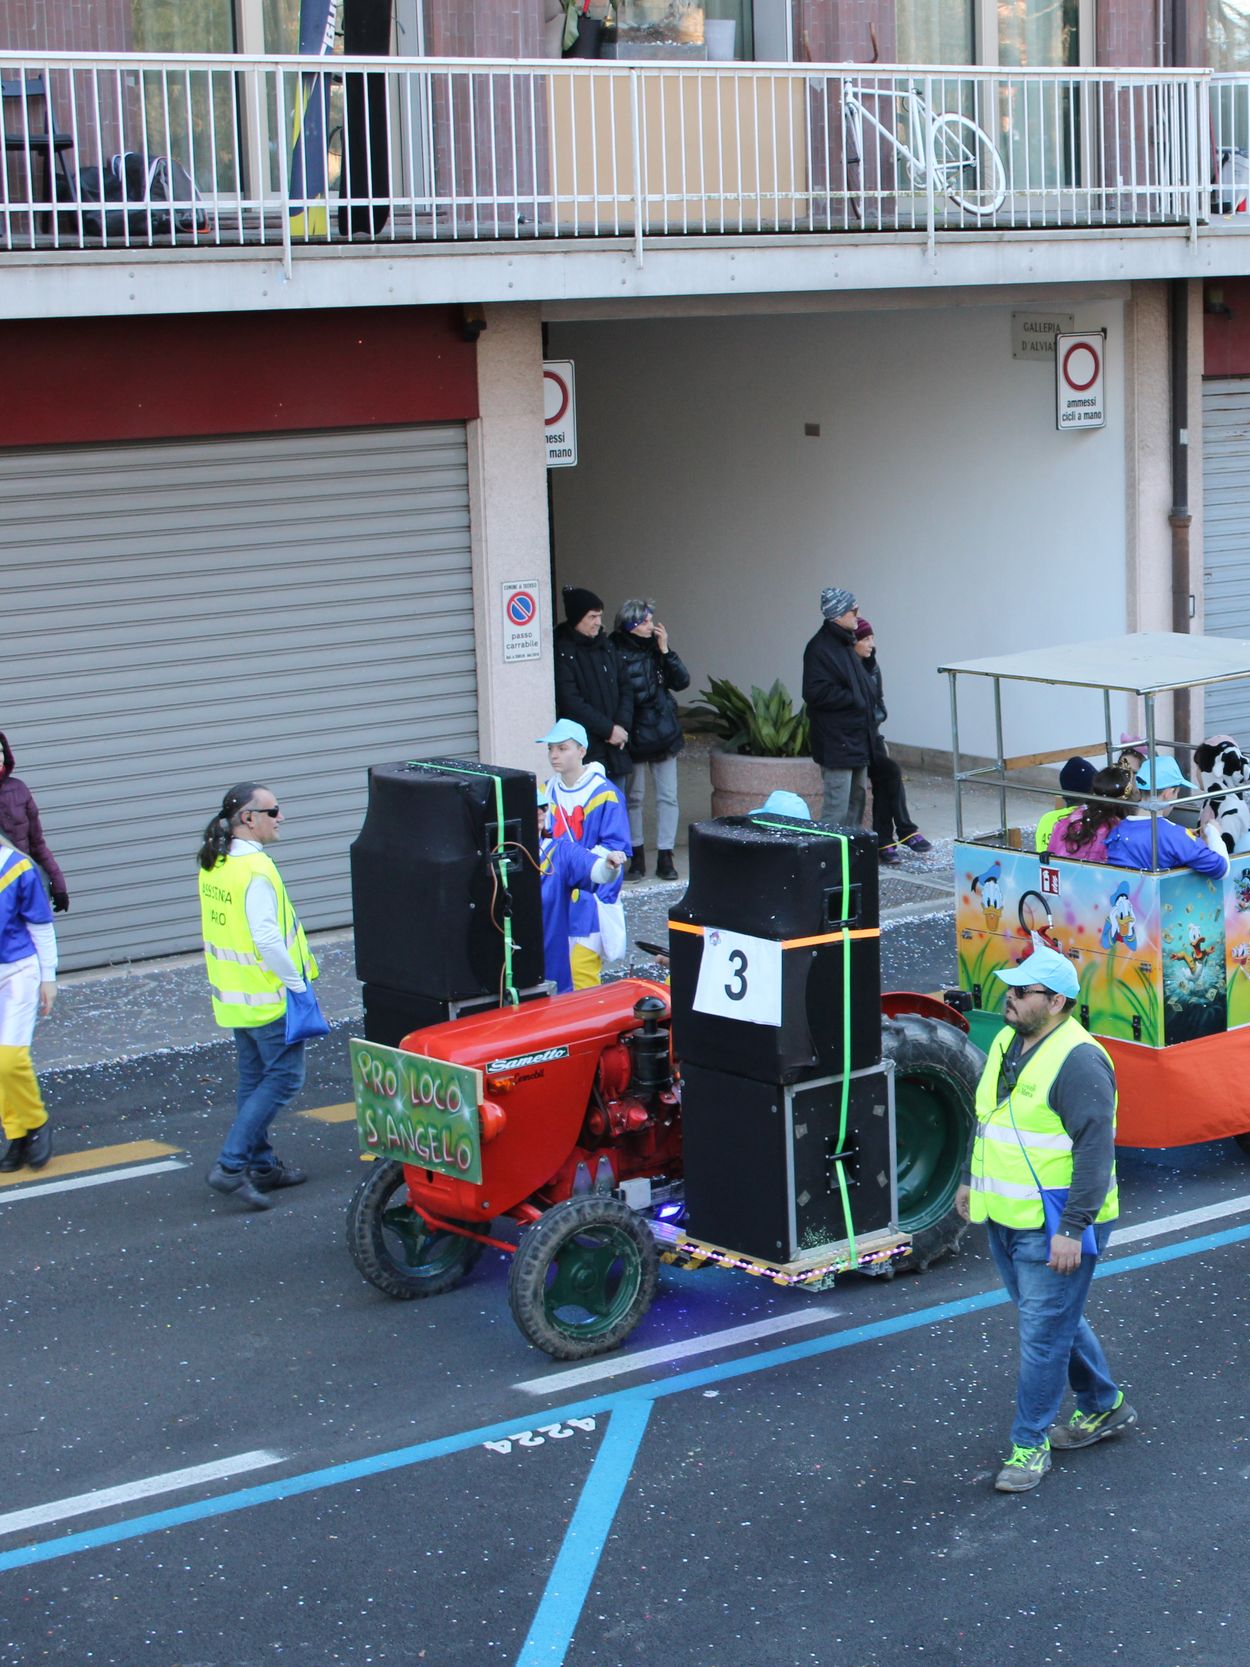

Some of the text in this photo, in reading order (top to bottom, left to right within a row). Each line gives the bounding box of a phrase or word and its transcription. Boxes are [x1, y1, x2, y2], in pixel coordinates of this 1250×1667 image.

[1023, 321, 1061, 334] GALLERIA
[1022, 340, 1056, 352] D'ALVIA
[1067, 397, 1097, 408] ammessi
[1062, 411, 1102, 422] cicli a mano
[549, 448, 573, 459] mano
[511, 632, 533, 641] passo
[506, 641, 539, 650] carrabile
[724, 948, 749, 1001] 3
[488, 1048, 567, 1073] Sametto
[358, 1051, 462, 1113] PRO LOCO
[482, 1417, 596, 1455] 4224
